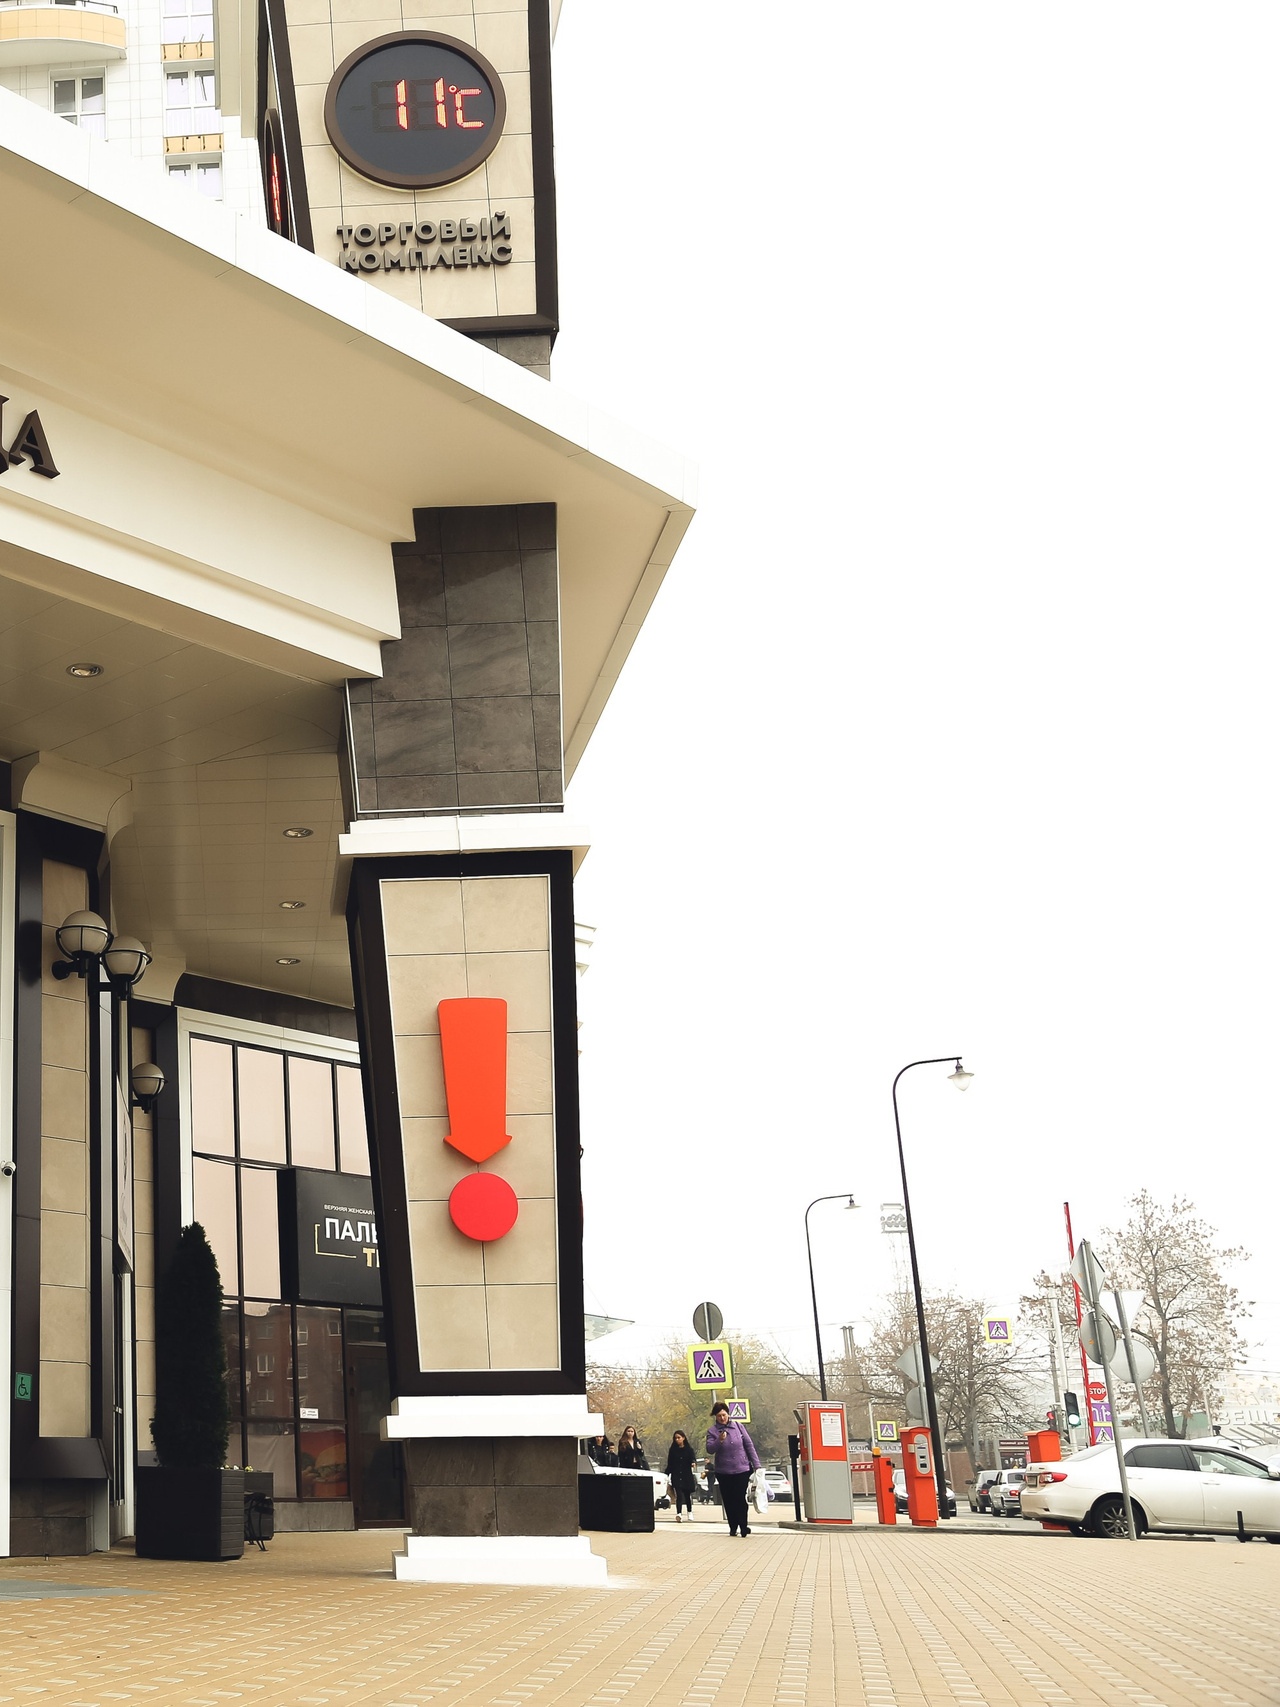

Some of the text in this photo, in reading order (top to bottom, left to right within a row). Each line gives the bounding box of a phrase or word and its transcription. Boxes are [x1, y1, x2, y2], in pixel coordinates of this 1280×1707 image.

[337, 211, 512, 248] ТОРГОВЫЙ
[338, 243, 513, 274] КОМПЛЕКС
[1089, 1387, 1106, 1395] STOP
